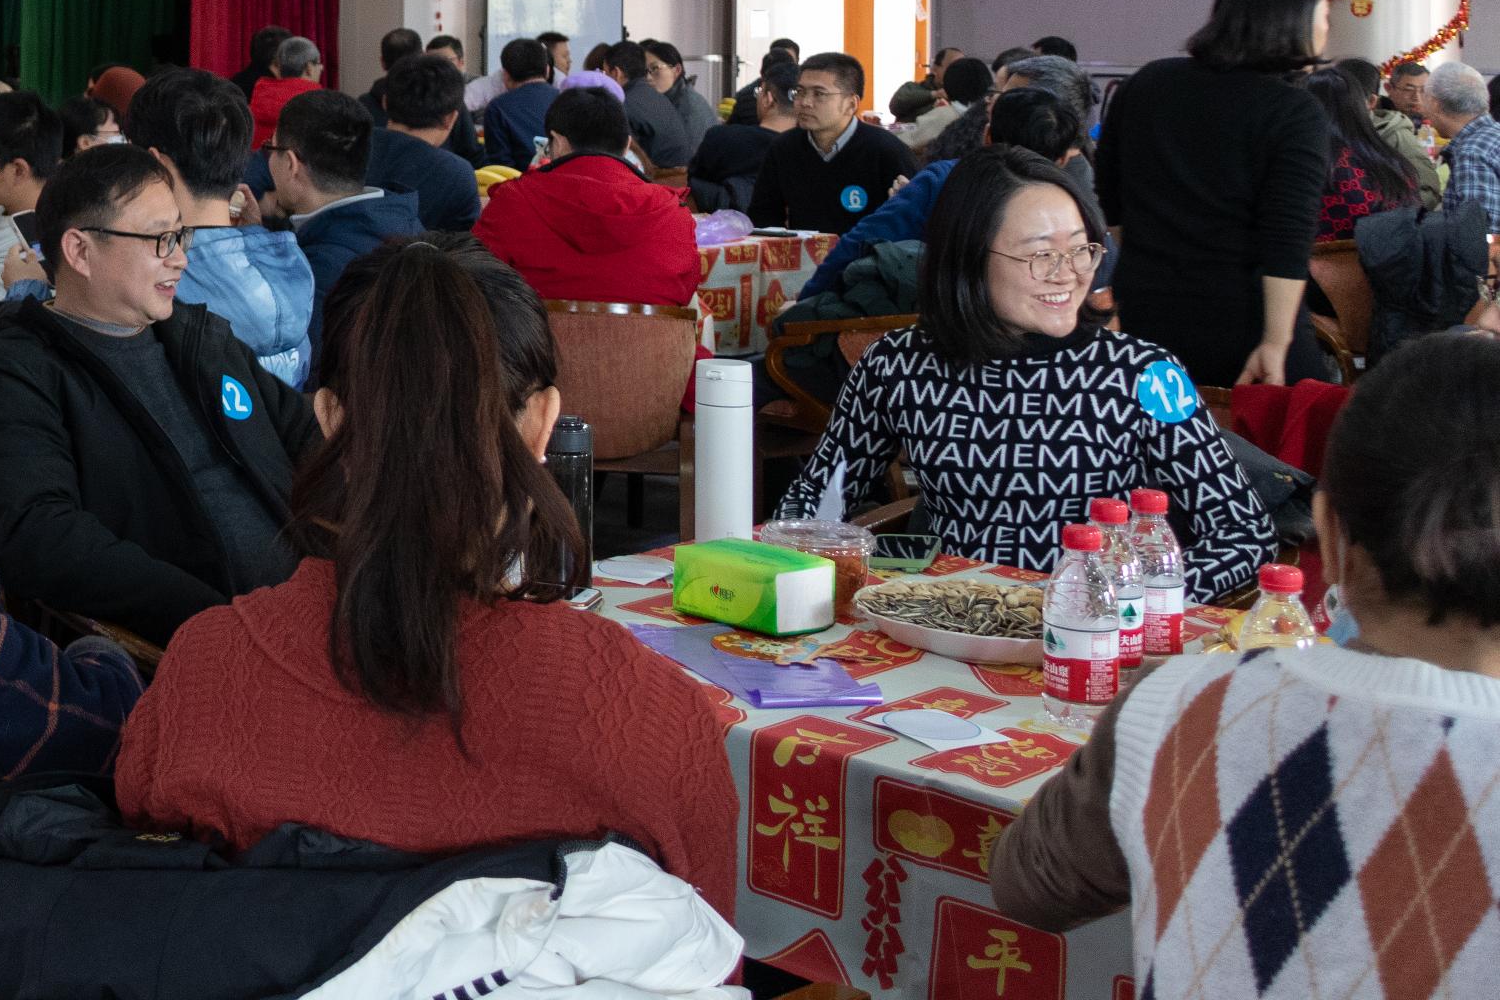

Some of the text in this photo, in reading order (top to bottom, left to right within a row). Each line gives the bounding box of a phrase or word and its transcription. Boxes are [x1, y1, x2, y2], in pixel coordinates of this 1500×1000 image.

[849, 190, 861, 208] 6
[1150, 368, 1193, 413] 12
[966, 928, 1033, 997] 平
